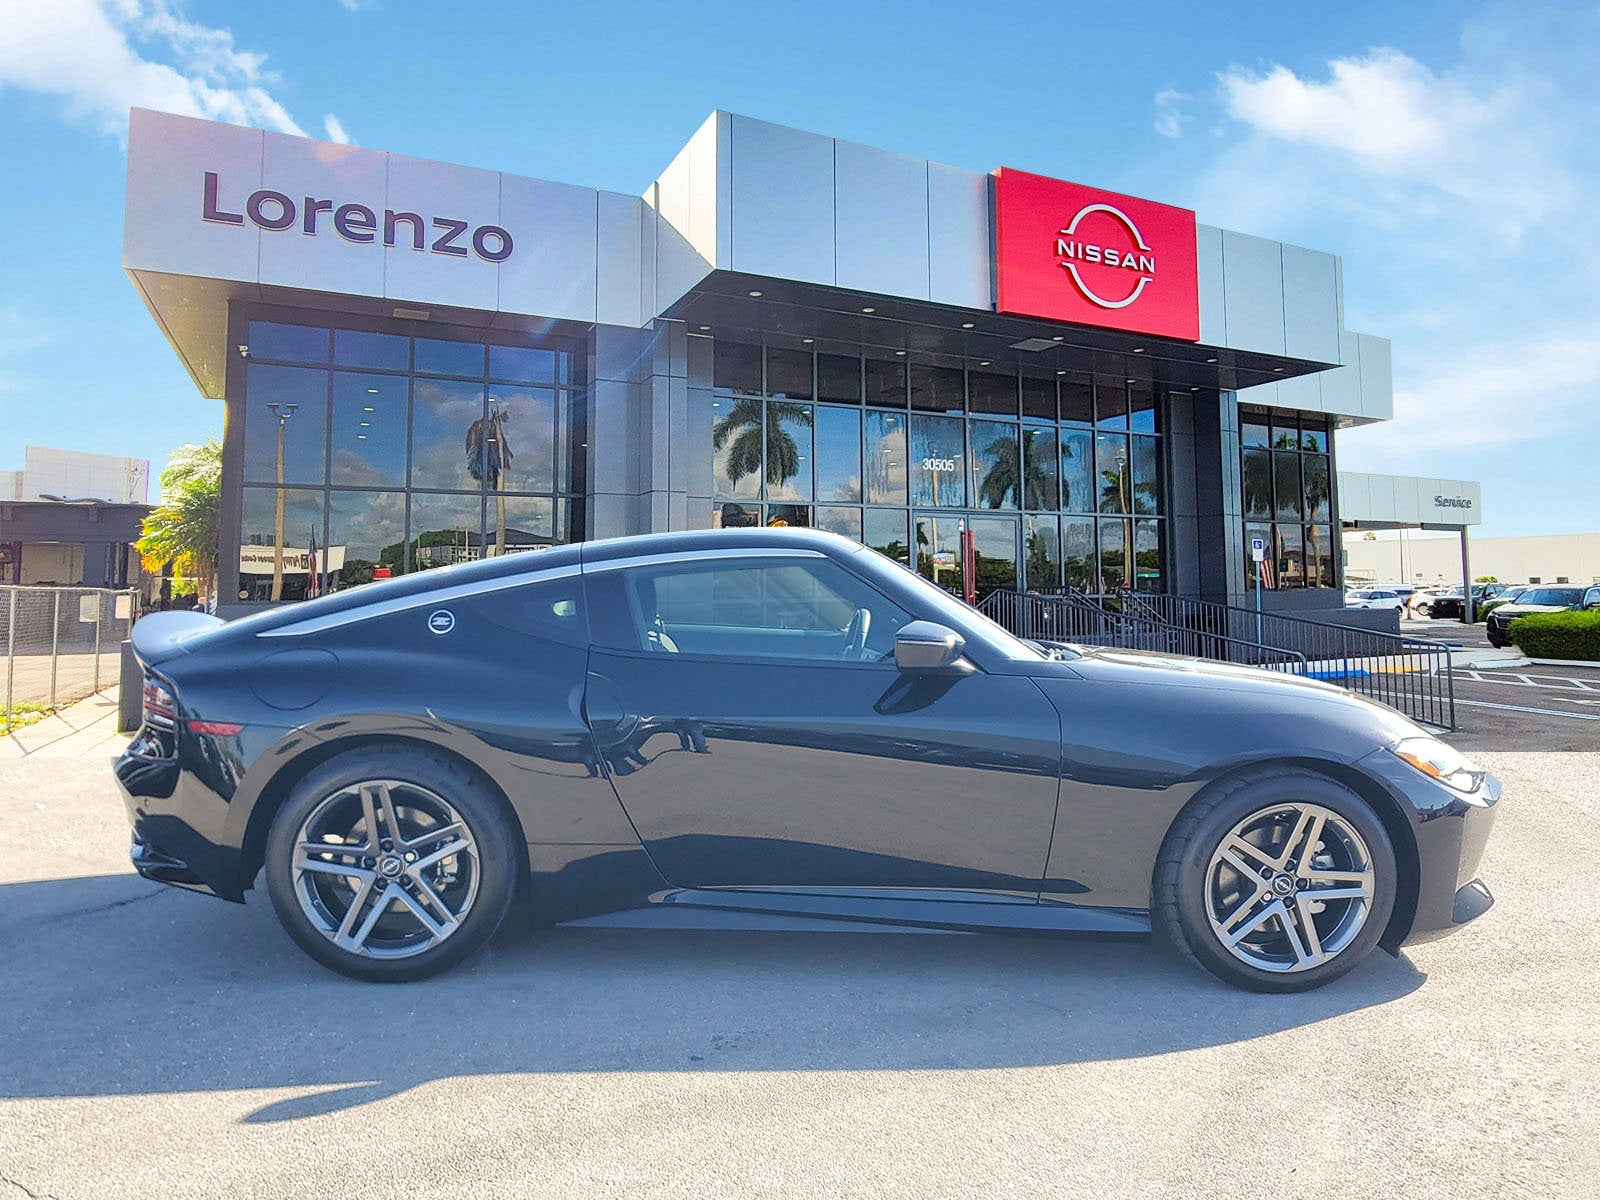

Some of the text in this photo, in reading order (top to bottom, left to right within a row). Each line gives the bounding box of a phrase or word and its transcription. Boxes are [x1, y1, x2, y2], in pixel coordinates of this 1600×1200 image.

[202, 171, 514, 262] Lorenzo
[1057, 238, 1155, 273] NISSAN
[922, 457, 954, 472] 30505
[1434, 495, 1472, 509] Service
